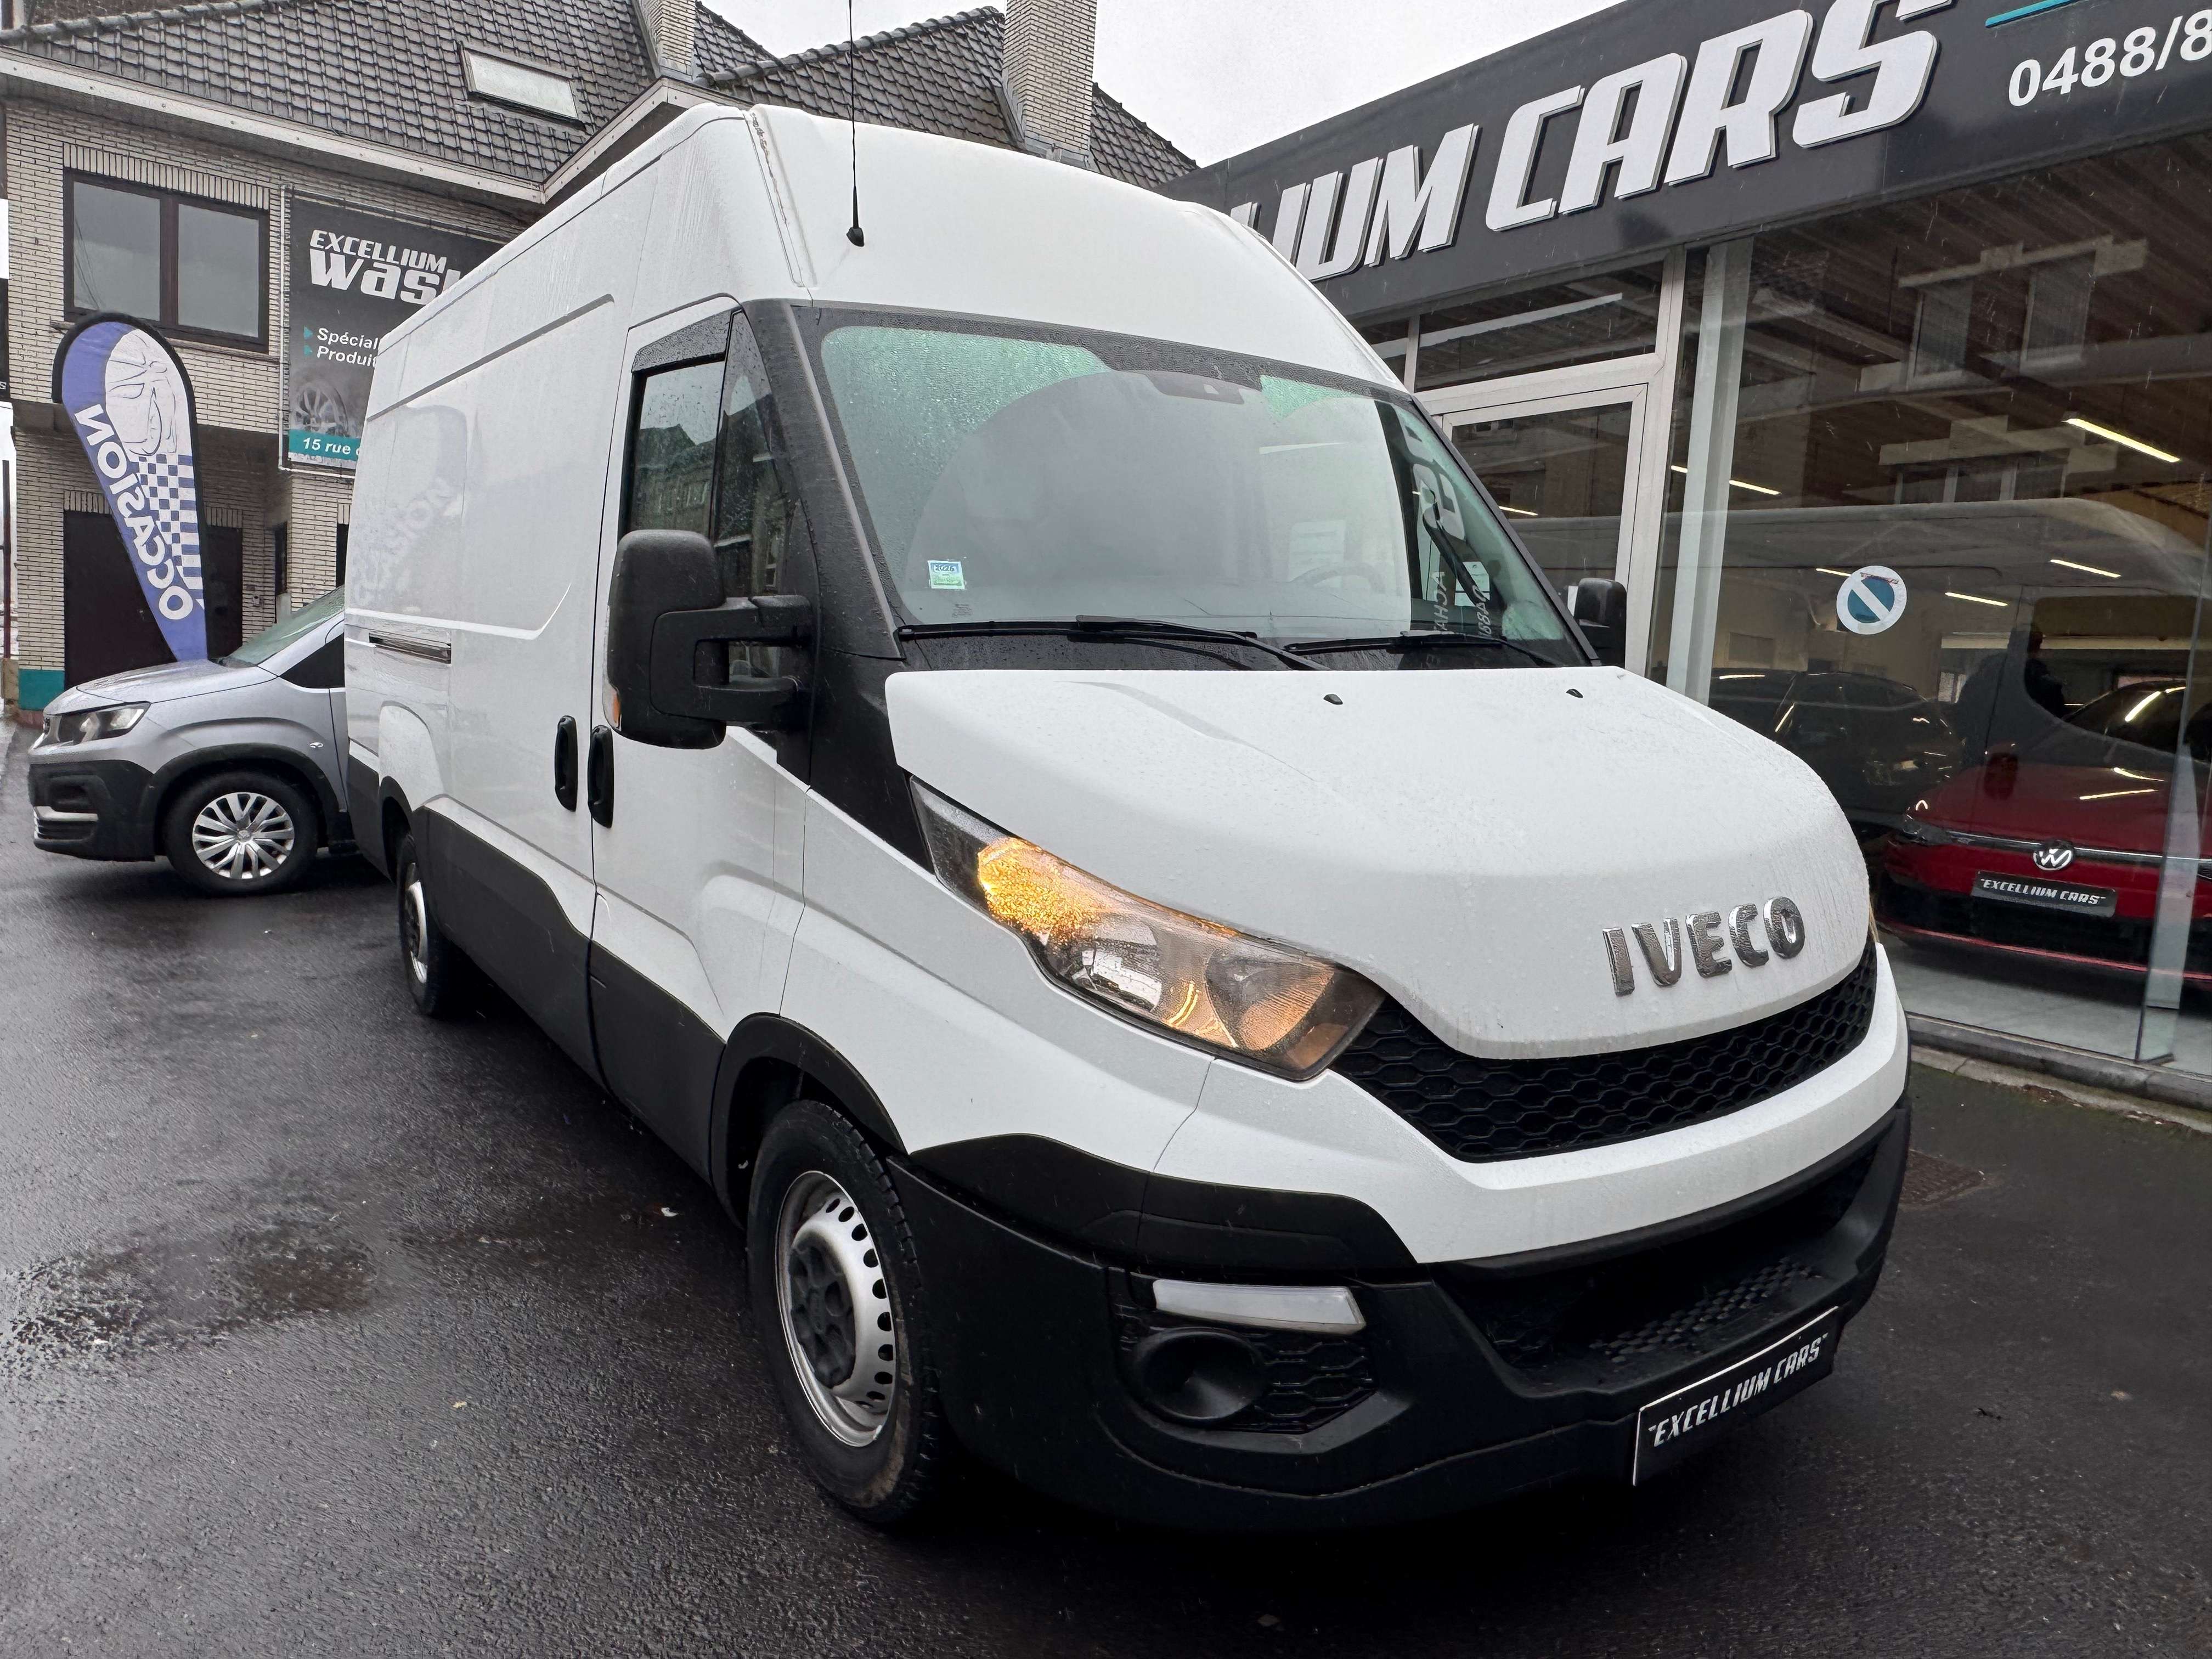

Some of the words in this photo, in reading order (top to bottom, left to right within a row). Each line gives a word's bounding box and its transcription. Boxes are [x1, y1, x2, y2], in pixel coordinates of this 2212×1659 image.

[2008, 9, 2212, 107] 0488/8
[1486, 0, 1953, 232] CARS
[310, 229, 447, 273] EXCELLIUM
[303, 437, 321, 450] 15
[325, 443, 351, 455] rue
[1983, 879, 2057, 899] EXCELLIUM
[2059, 890, 2100, 905] CARS
[1602, 896, 1806, 997] IVECO
[1653, 1367, 1772, 1447] EXCELLIUM
[1773, 1336, 1822, 1384] CARS
